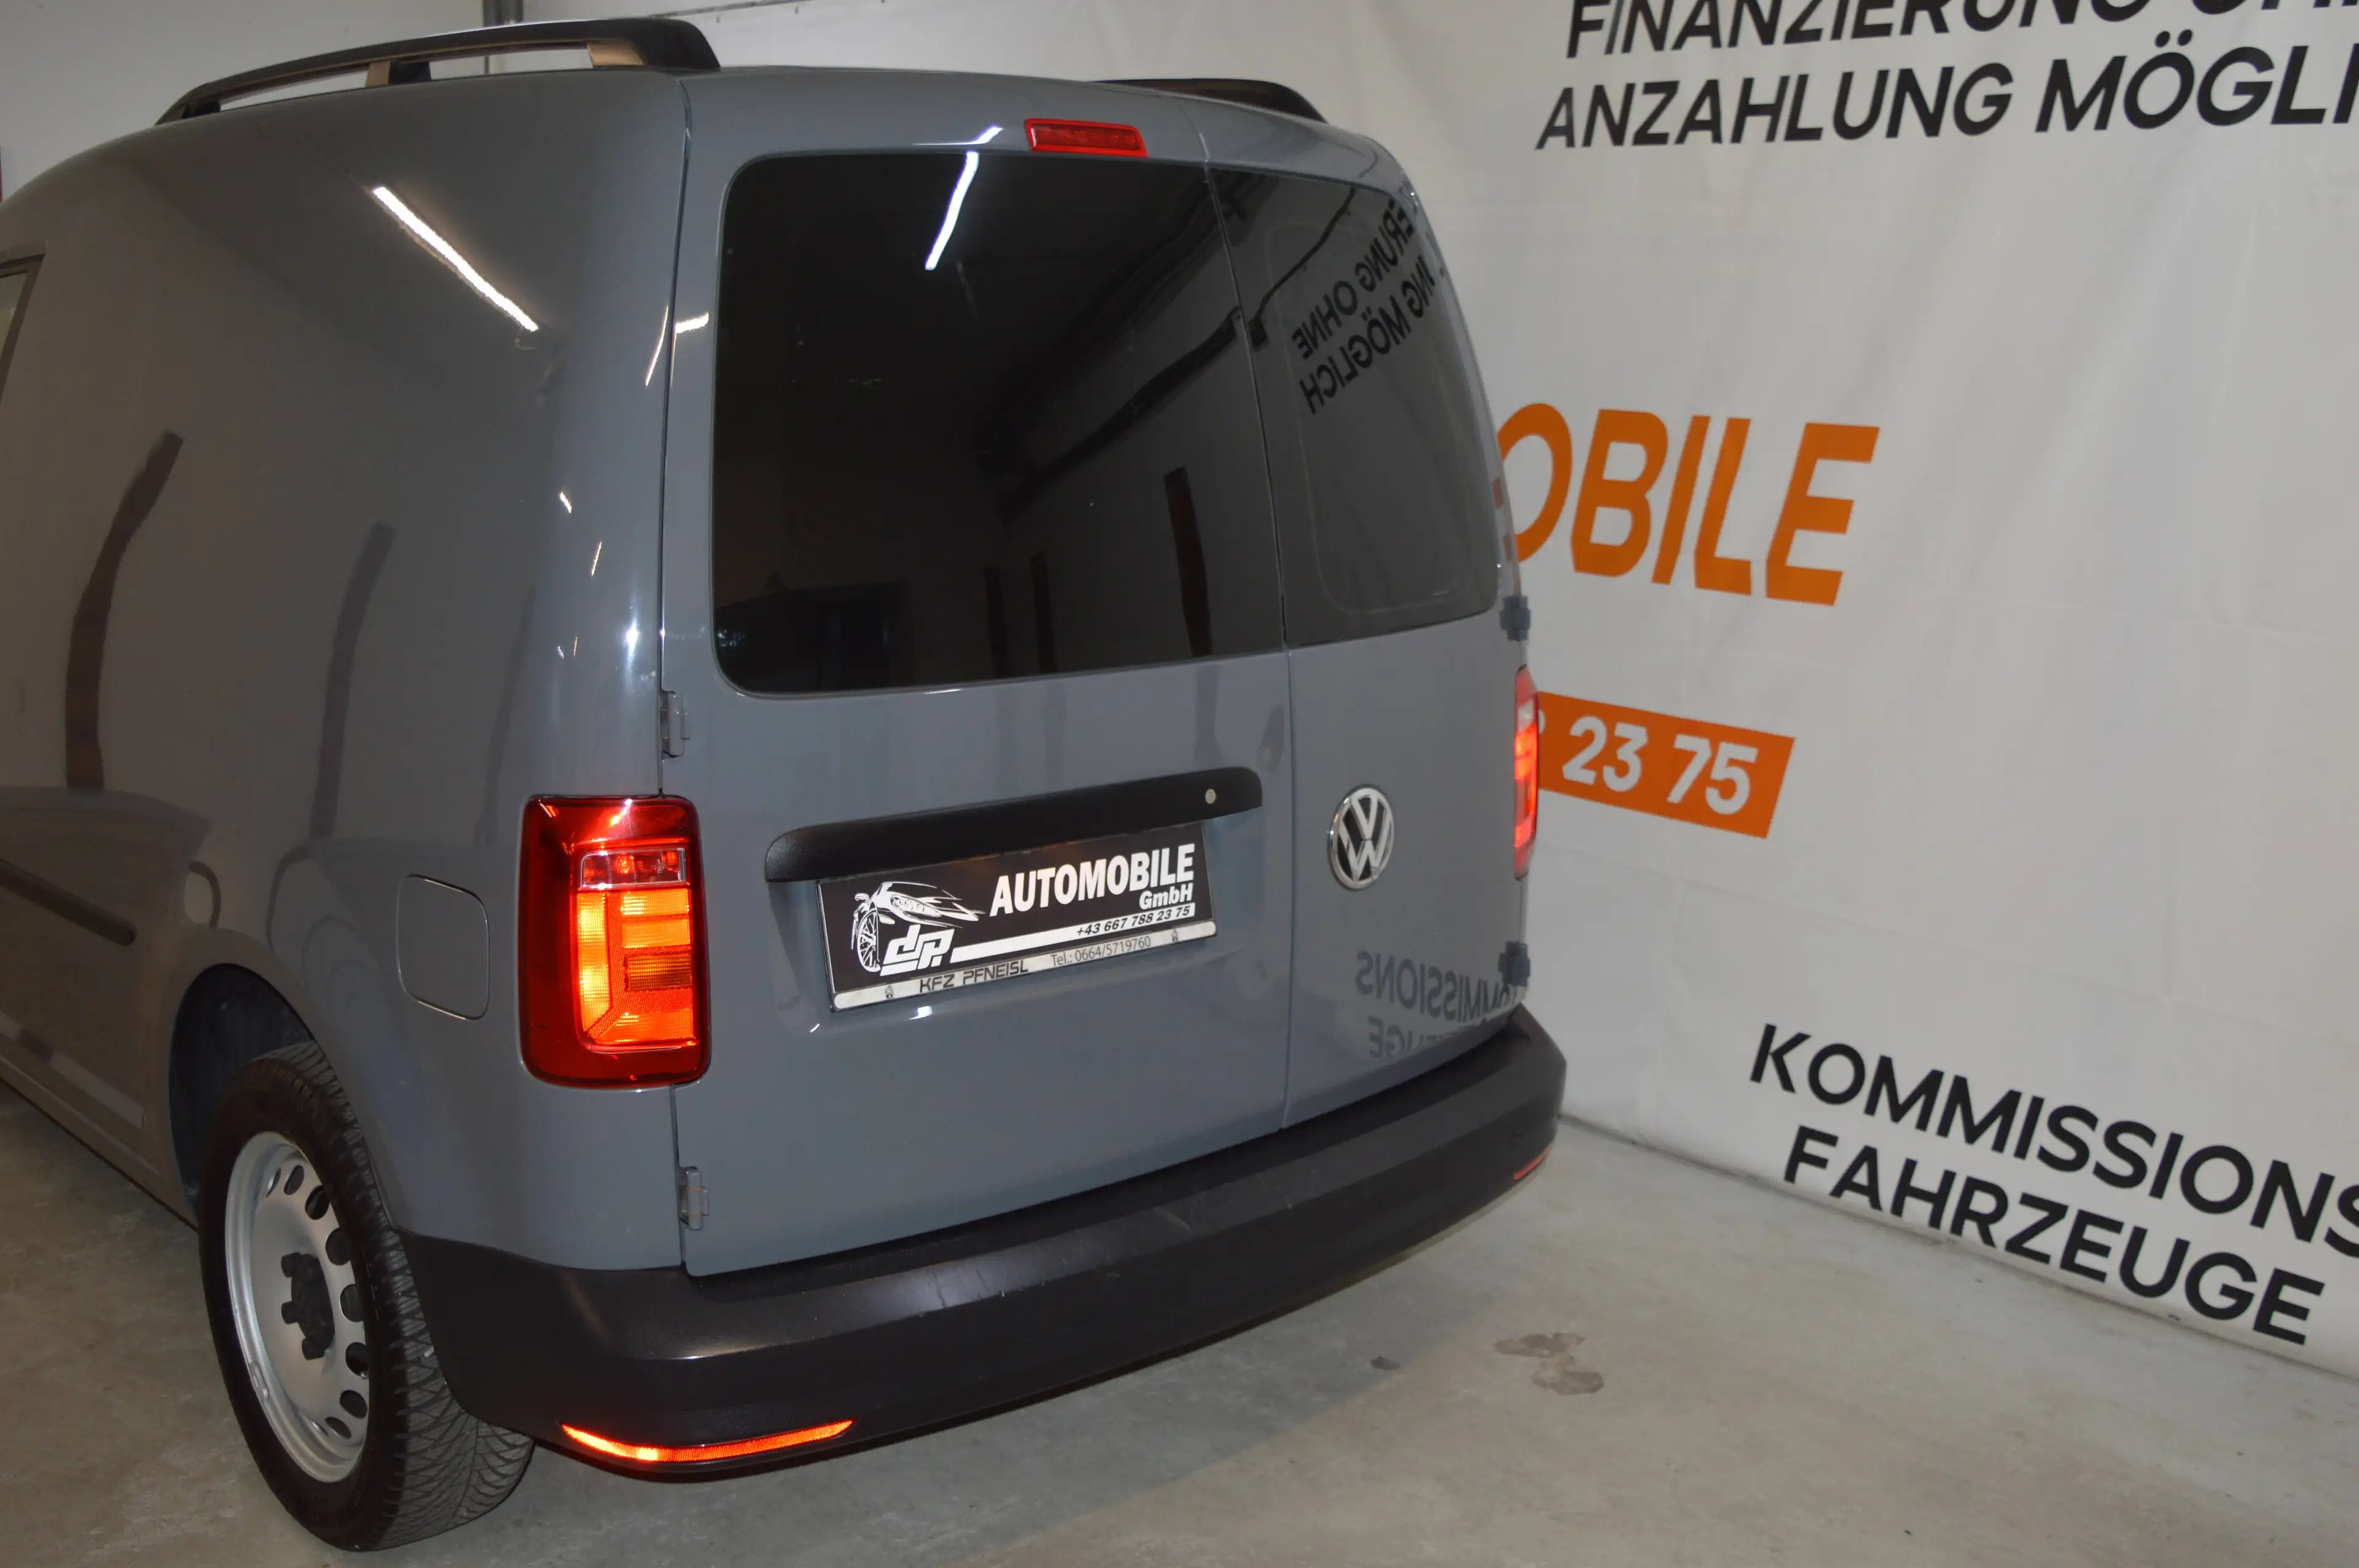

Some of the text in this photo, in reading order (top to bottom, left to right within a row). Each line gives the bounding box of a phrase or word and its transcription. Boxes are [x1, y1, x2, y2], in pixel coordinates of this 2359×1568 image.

[1535, 61, 2014, 149] ANZAHLUNG
[1561, 716, 1759, 815] 23 75
[989, 843, 1195, 918] AUTOMOBILE
[1138, 883, 1194, 910] GmbH
[1076, 905, 1191, 937] +43 667 788 23 75
[920, 973, 956, 993] KFZ
[963, 960, 1029, 985] PFNEISL
[1074, 935, 1152, 962] 0664/5719760
[1783, 1125, 2326, 1346] FAHRZEUGE
